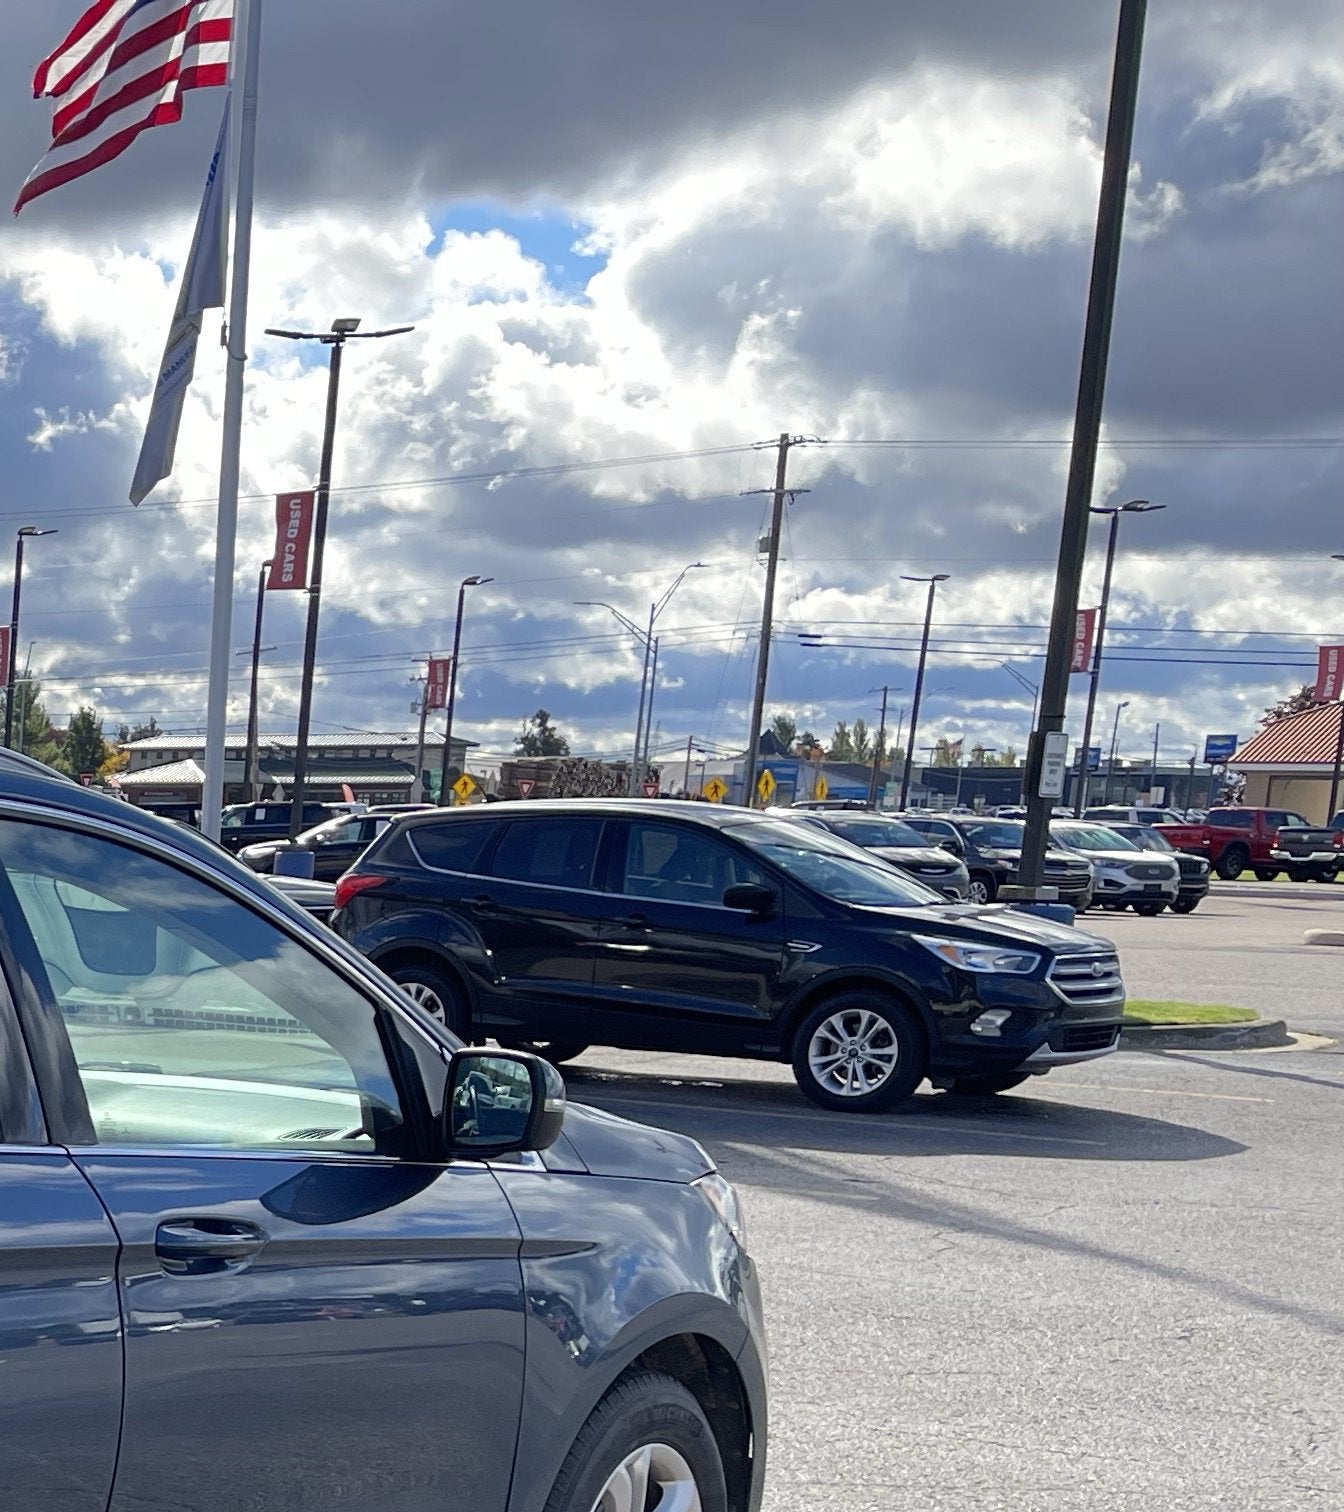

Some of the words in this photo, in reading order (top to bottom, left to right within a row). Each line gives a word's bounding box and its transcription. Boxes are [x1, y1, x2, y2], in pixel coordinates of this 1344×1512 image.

[286, 498, 302, 539] USED
[281, 542, 297, 583] CARS
[1075, 613, 1087, 640] USED
[1327, 649, 1339, 673] USED
[1323, 674, 1336, 698] CARS
